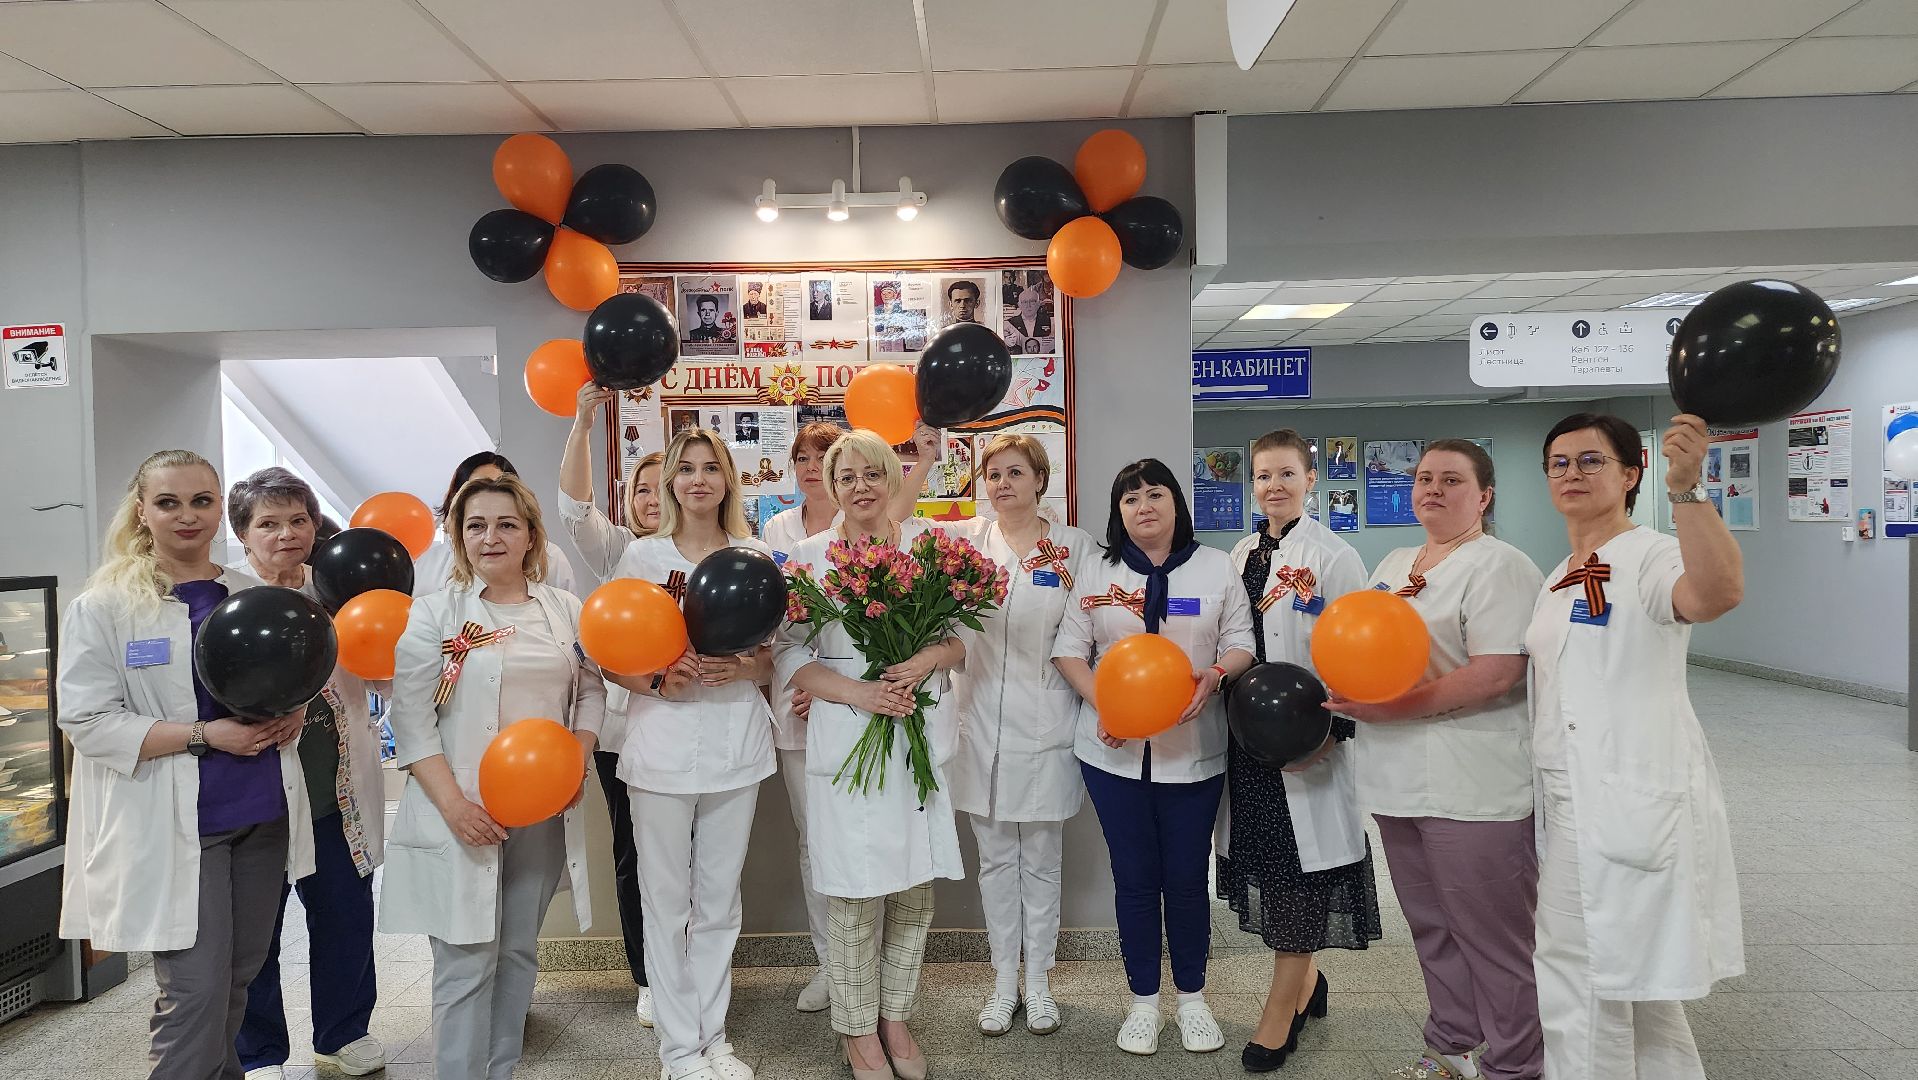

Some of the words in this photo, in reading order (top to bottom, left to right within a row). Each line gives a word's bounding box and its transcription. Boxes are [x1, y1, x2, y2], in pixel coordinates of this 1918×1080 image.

[9, 327, 57, 338] ВНИМАНИЕ
[1570, 365, 1623, 375] Терапевты
[661, 367, 679, 390] С
[683, 362, 763, 395] ДНЁМ
